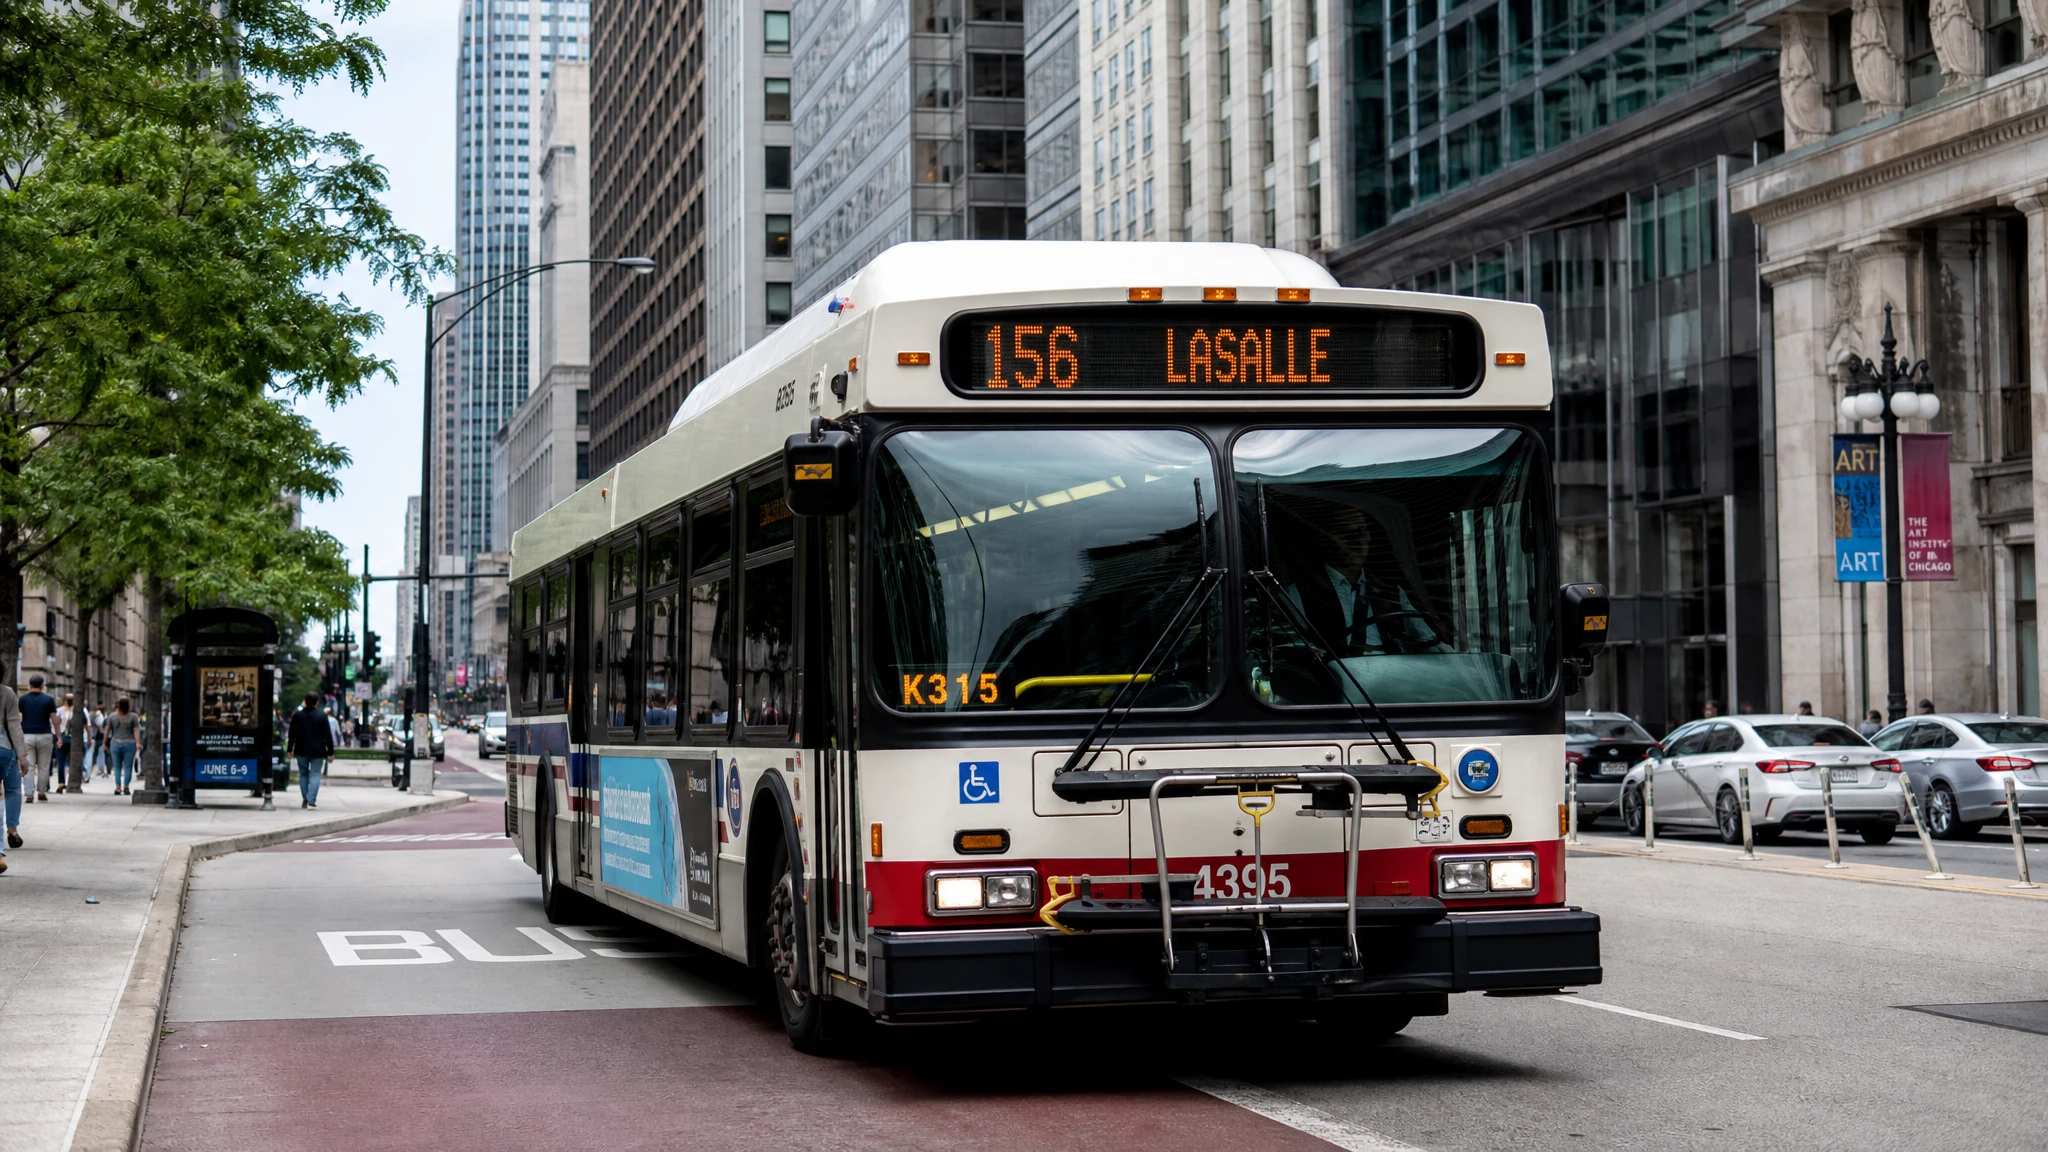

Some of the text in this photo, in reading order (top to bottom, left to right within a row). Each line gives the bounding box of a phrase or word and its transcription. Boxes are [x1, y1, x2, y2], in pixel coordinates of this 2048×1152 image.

[987, 325, 1331, 389] 156 LASALLE
[1835, 448, 1879, 472] ART
[1907, 517, 1928, 527] THE
[1908, 528, 1928, 538] ART
[1908, 551, 1921, 560] OF
[1840, 552, 1880, 572] ART
[1908, 562, 1952, 572] CHICAGO
[201, 764, 228, 775] JUNE
[1193, 863, 1292, 899] 4395
